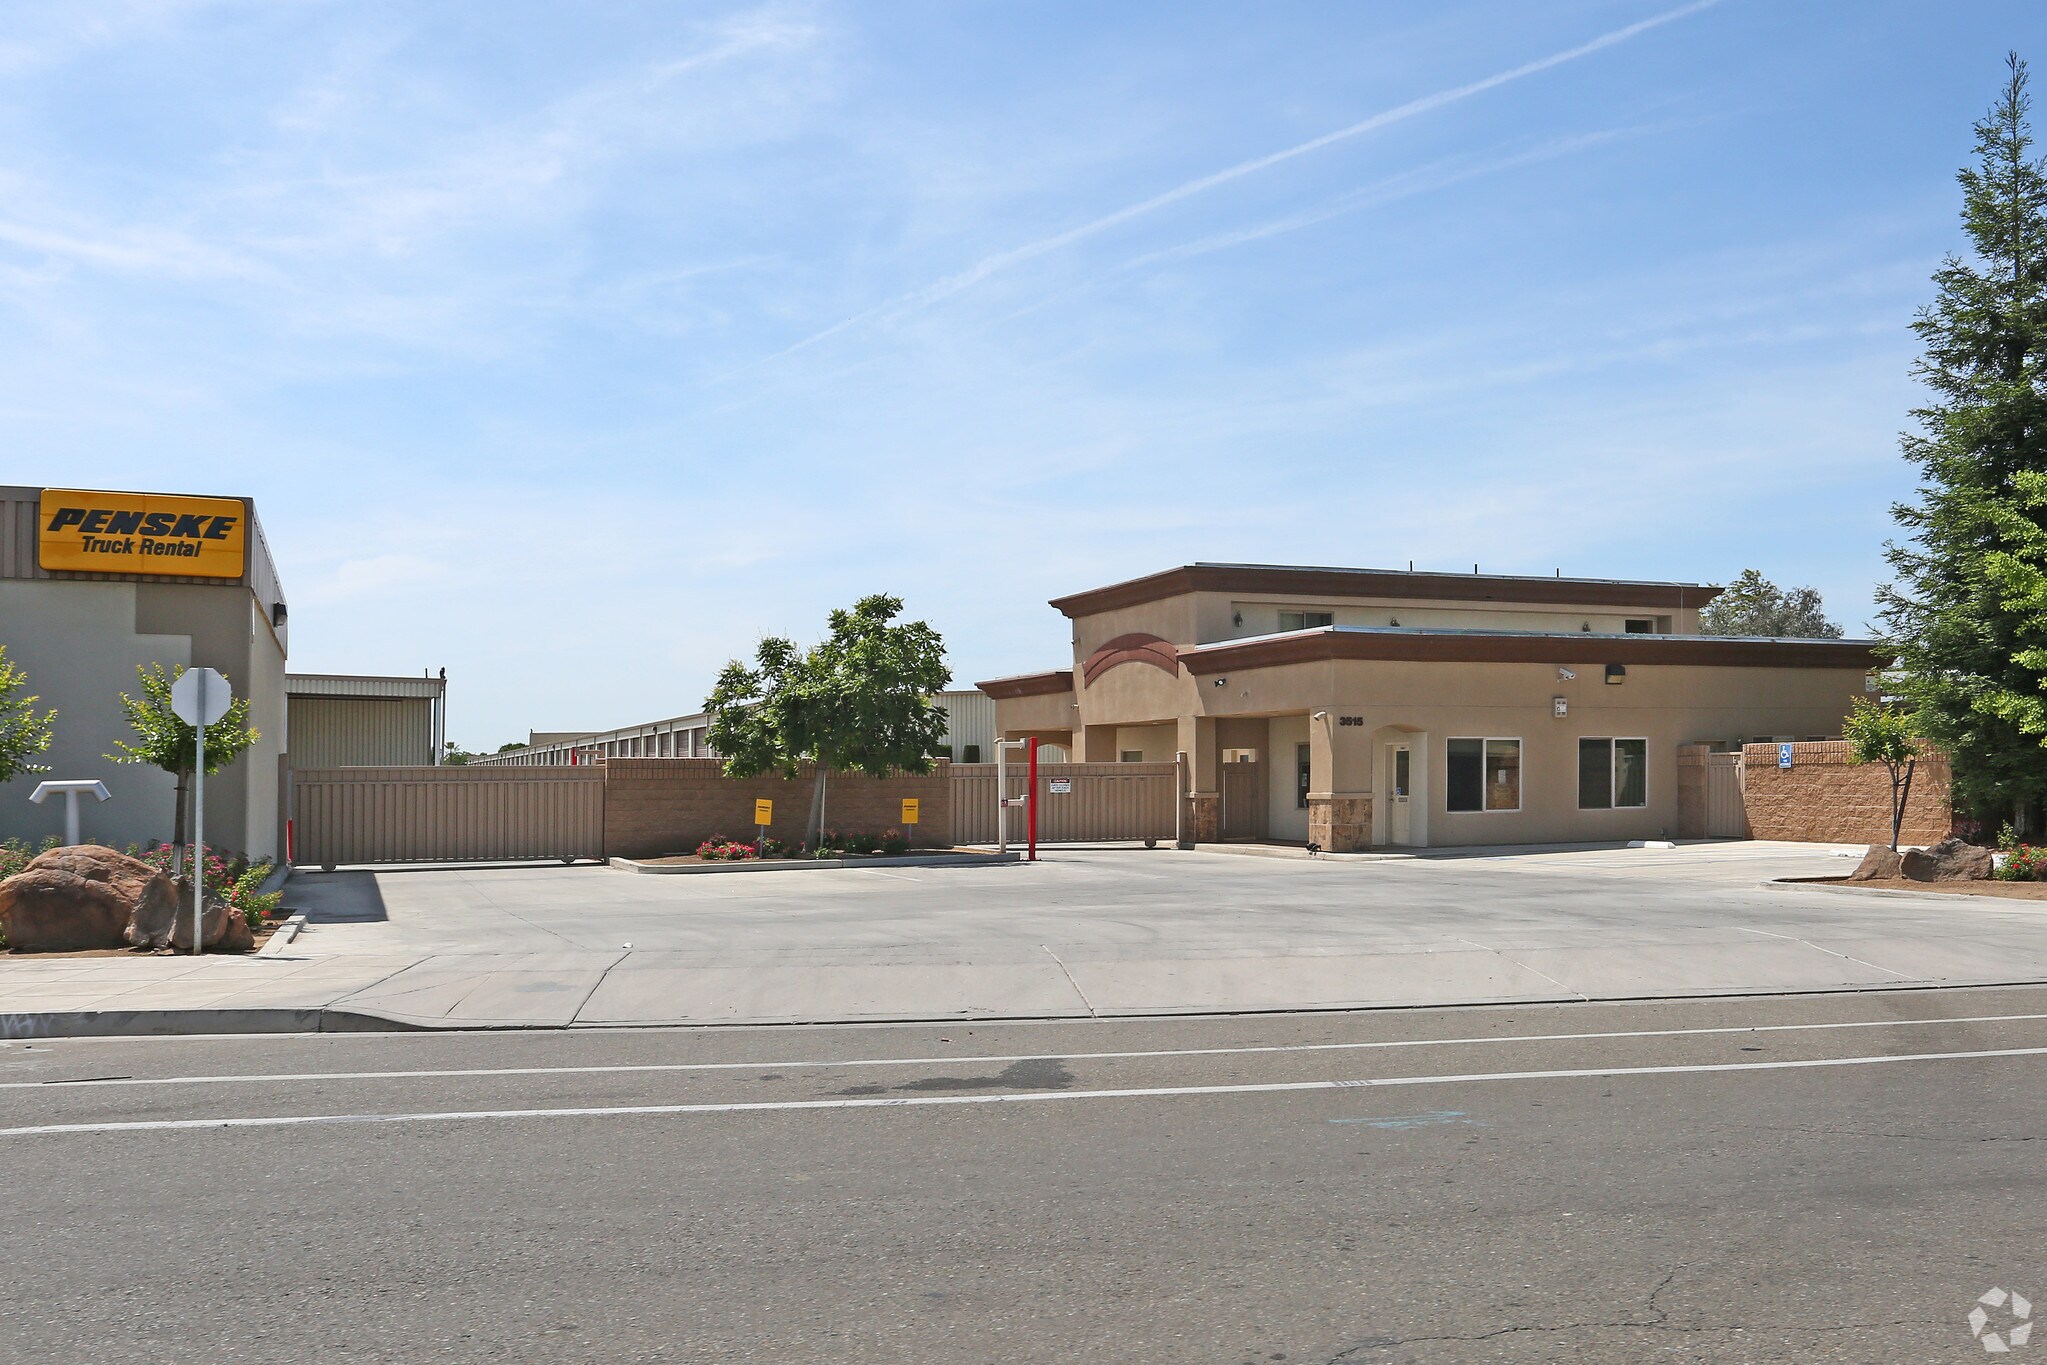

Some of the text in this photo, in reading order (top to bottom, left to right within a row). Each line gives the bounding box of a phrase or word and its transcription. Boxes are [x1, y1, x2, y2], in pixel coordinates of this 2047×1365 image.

[47, 507, 238, 540] PENSKE
[82, 535, 203, 558] Truck Rental
